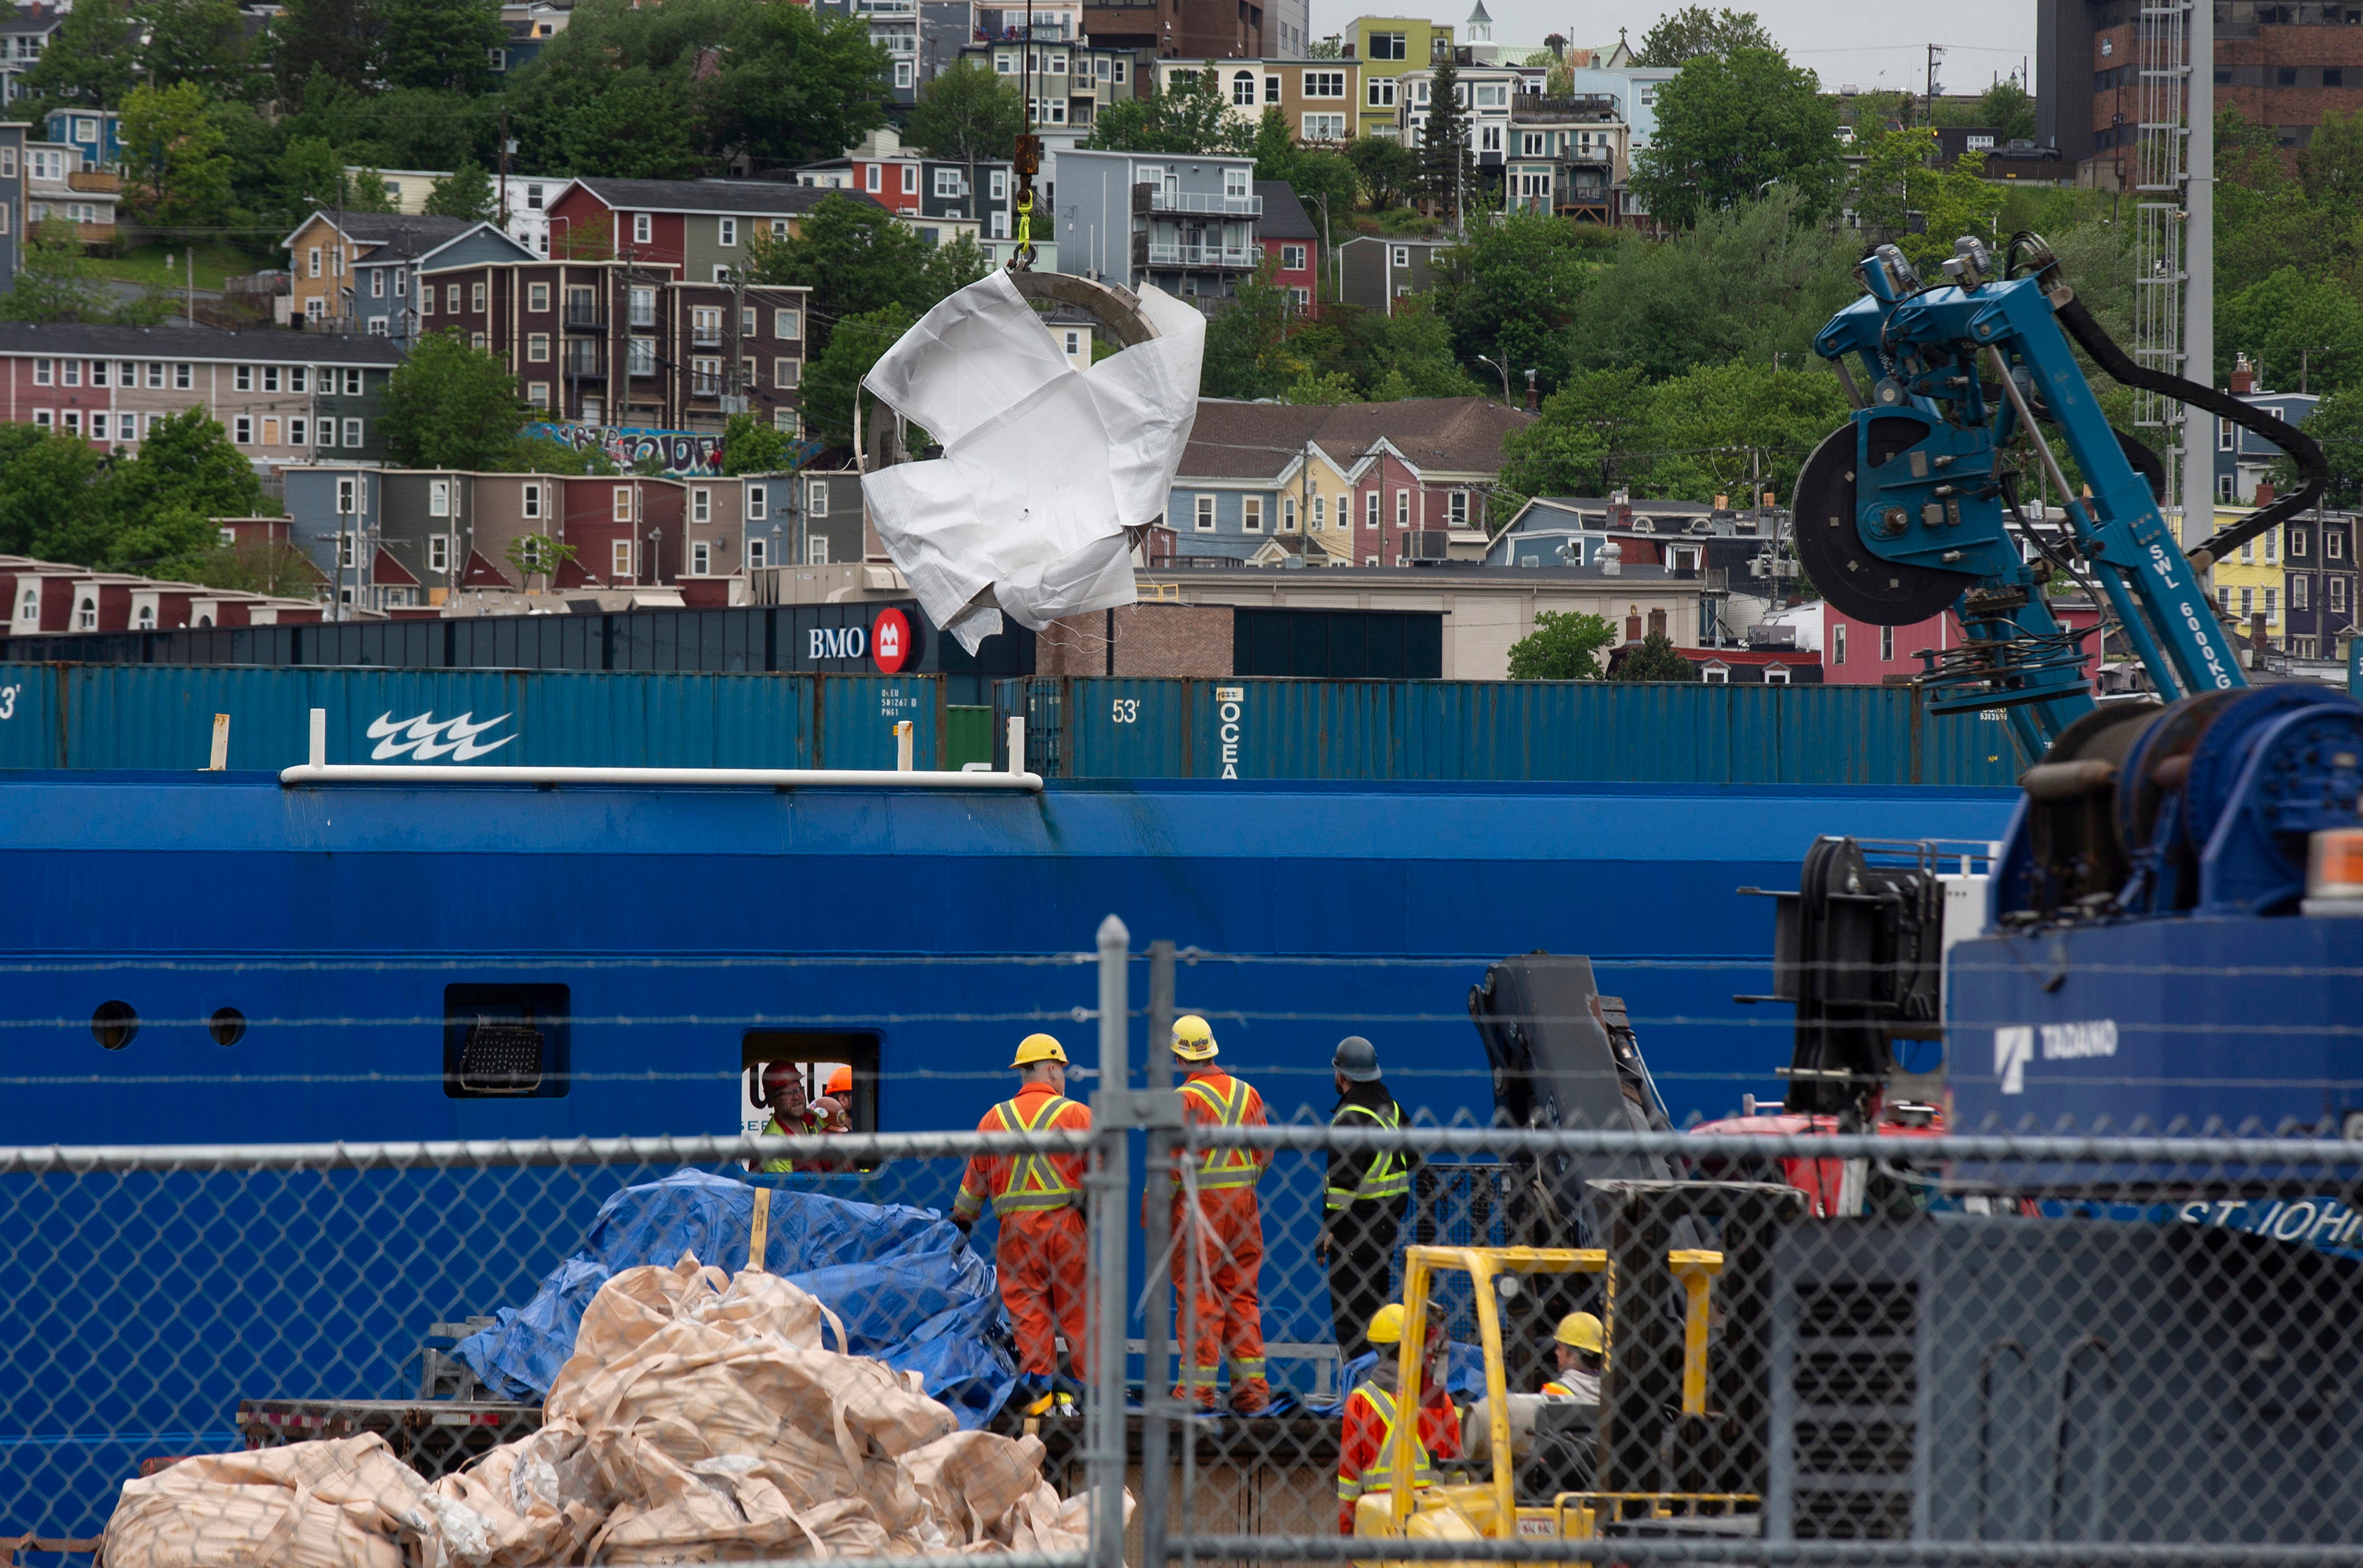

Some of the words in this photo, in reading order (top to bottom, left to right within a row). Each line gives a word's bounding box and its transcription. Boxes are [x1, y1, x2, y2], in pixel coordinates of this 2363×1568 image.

[2149, 544, 2180, 589] SWL
[2180, 602, 2232, 689] 6000KG
[809, 627, 864, 658] BMO
[0, 684, 20, 719] 3'
[1113, 699, 1140, 723] 53'
